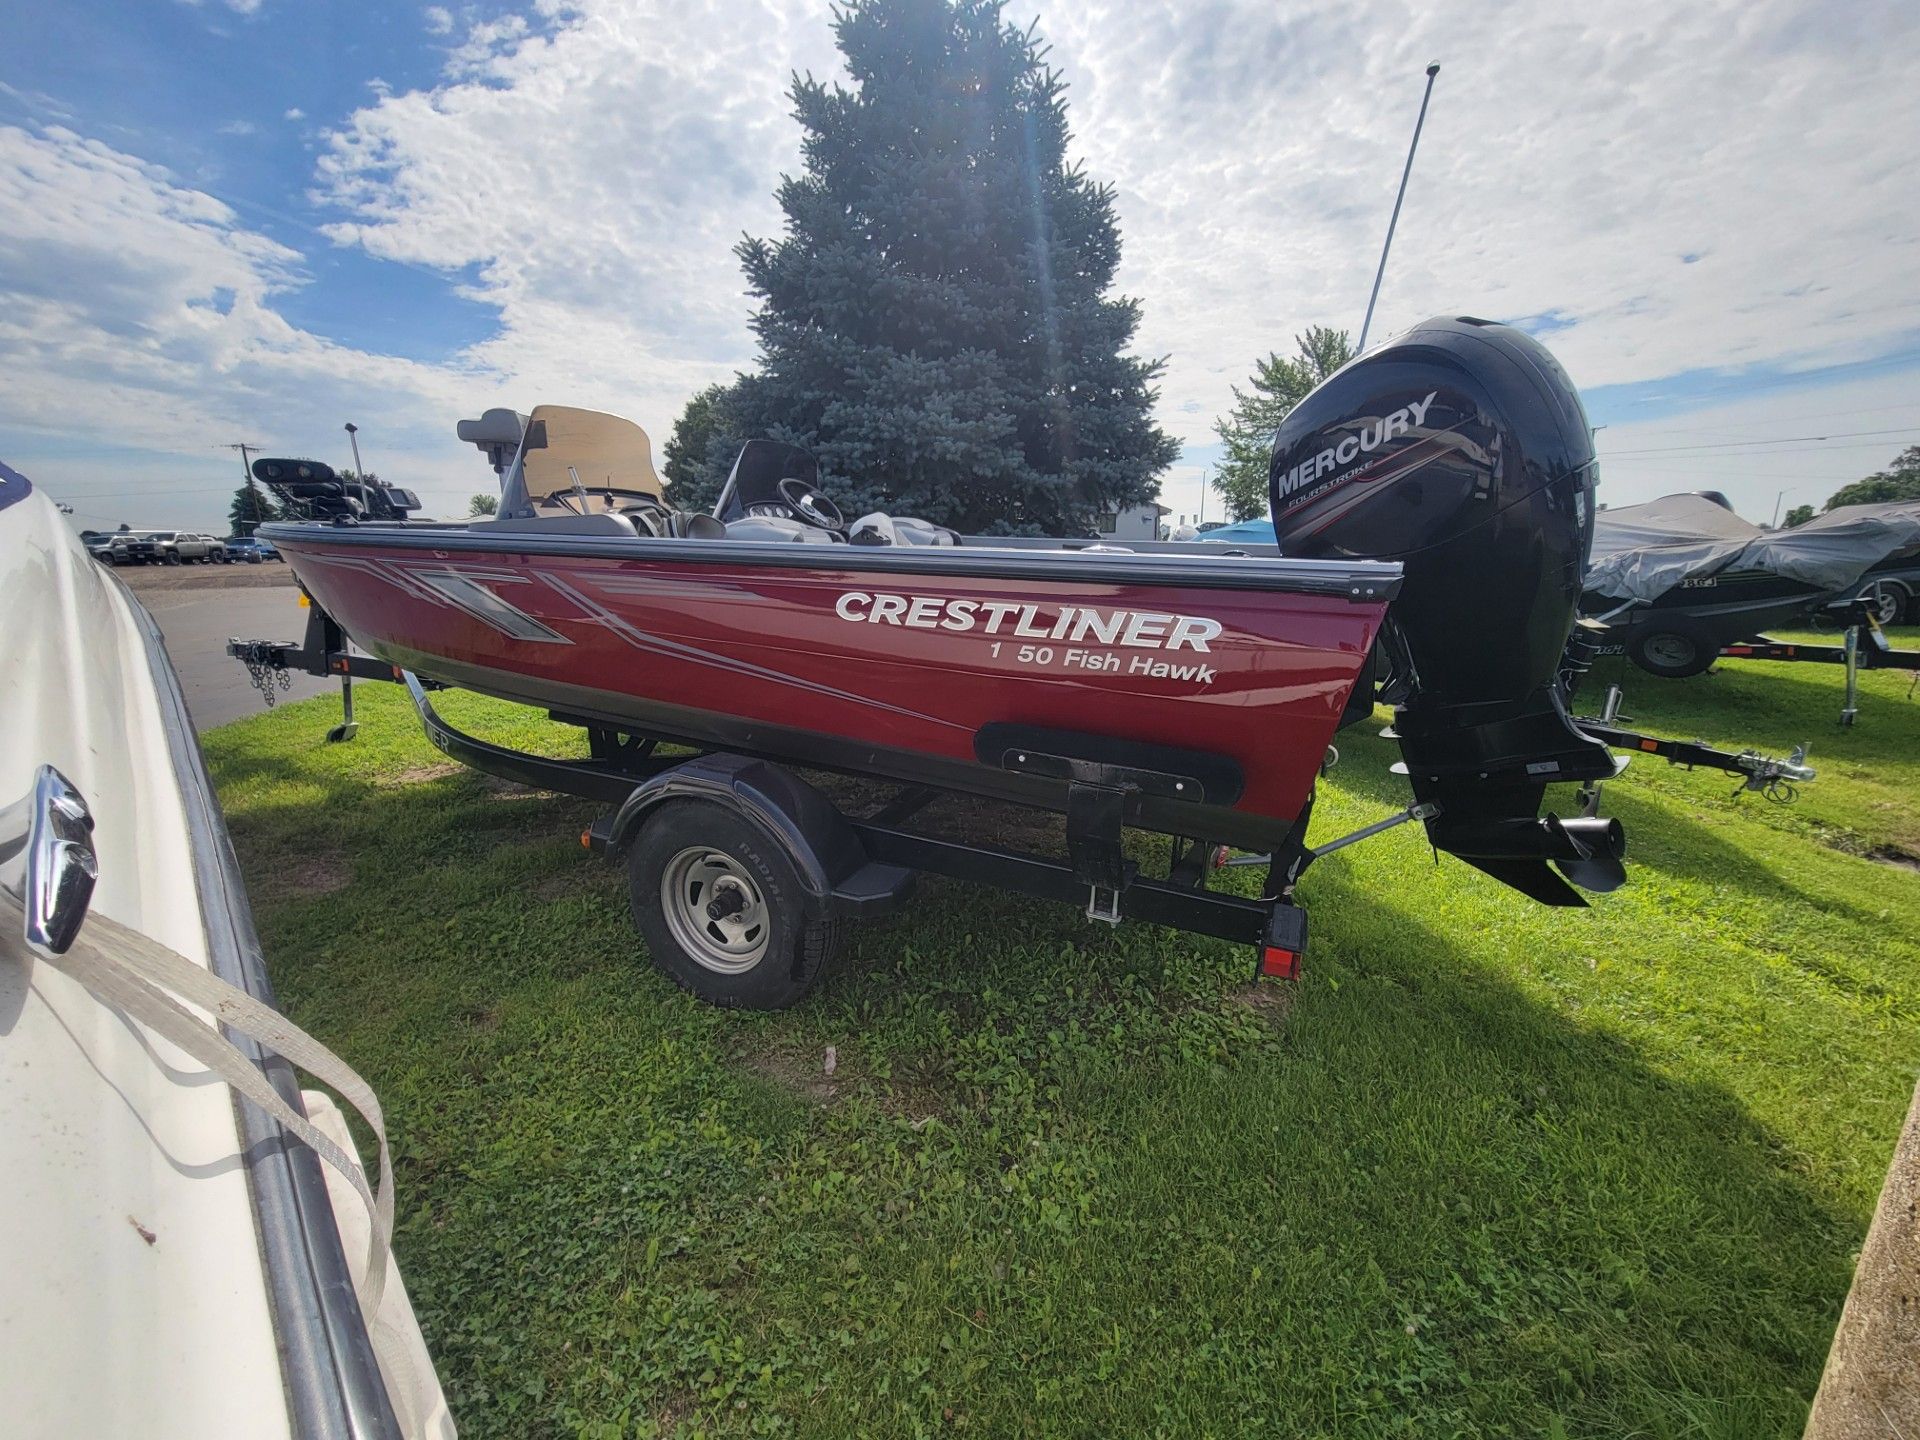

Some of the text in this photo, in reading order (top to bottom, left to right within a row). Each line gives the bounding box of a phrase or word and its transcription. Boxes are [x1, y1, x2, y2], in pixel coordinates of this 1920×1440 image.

[1278, 391, 1437, 499] MERCURY
[1289, 460, 1374, 507] FOURSTROKE
[835, 591, 1222, 653] CRESTLINER
[1017, 645, 1054, 665] 50
[1063, 648, 1121, 672] Fish
[1128, 655, 1218, 684] Hawk
[739, 842, 784, 905] RADIAL
